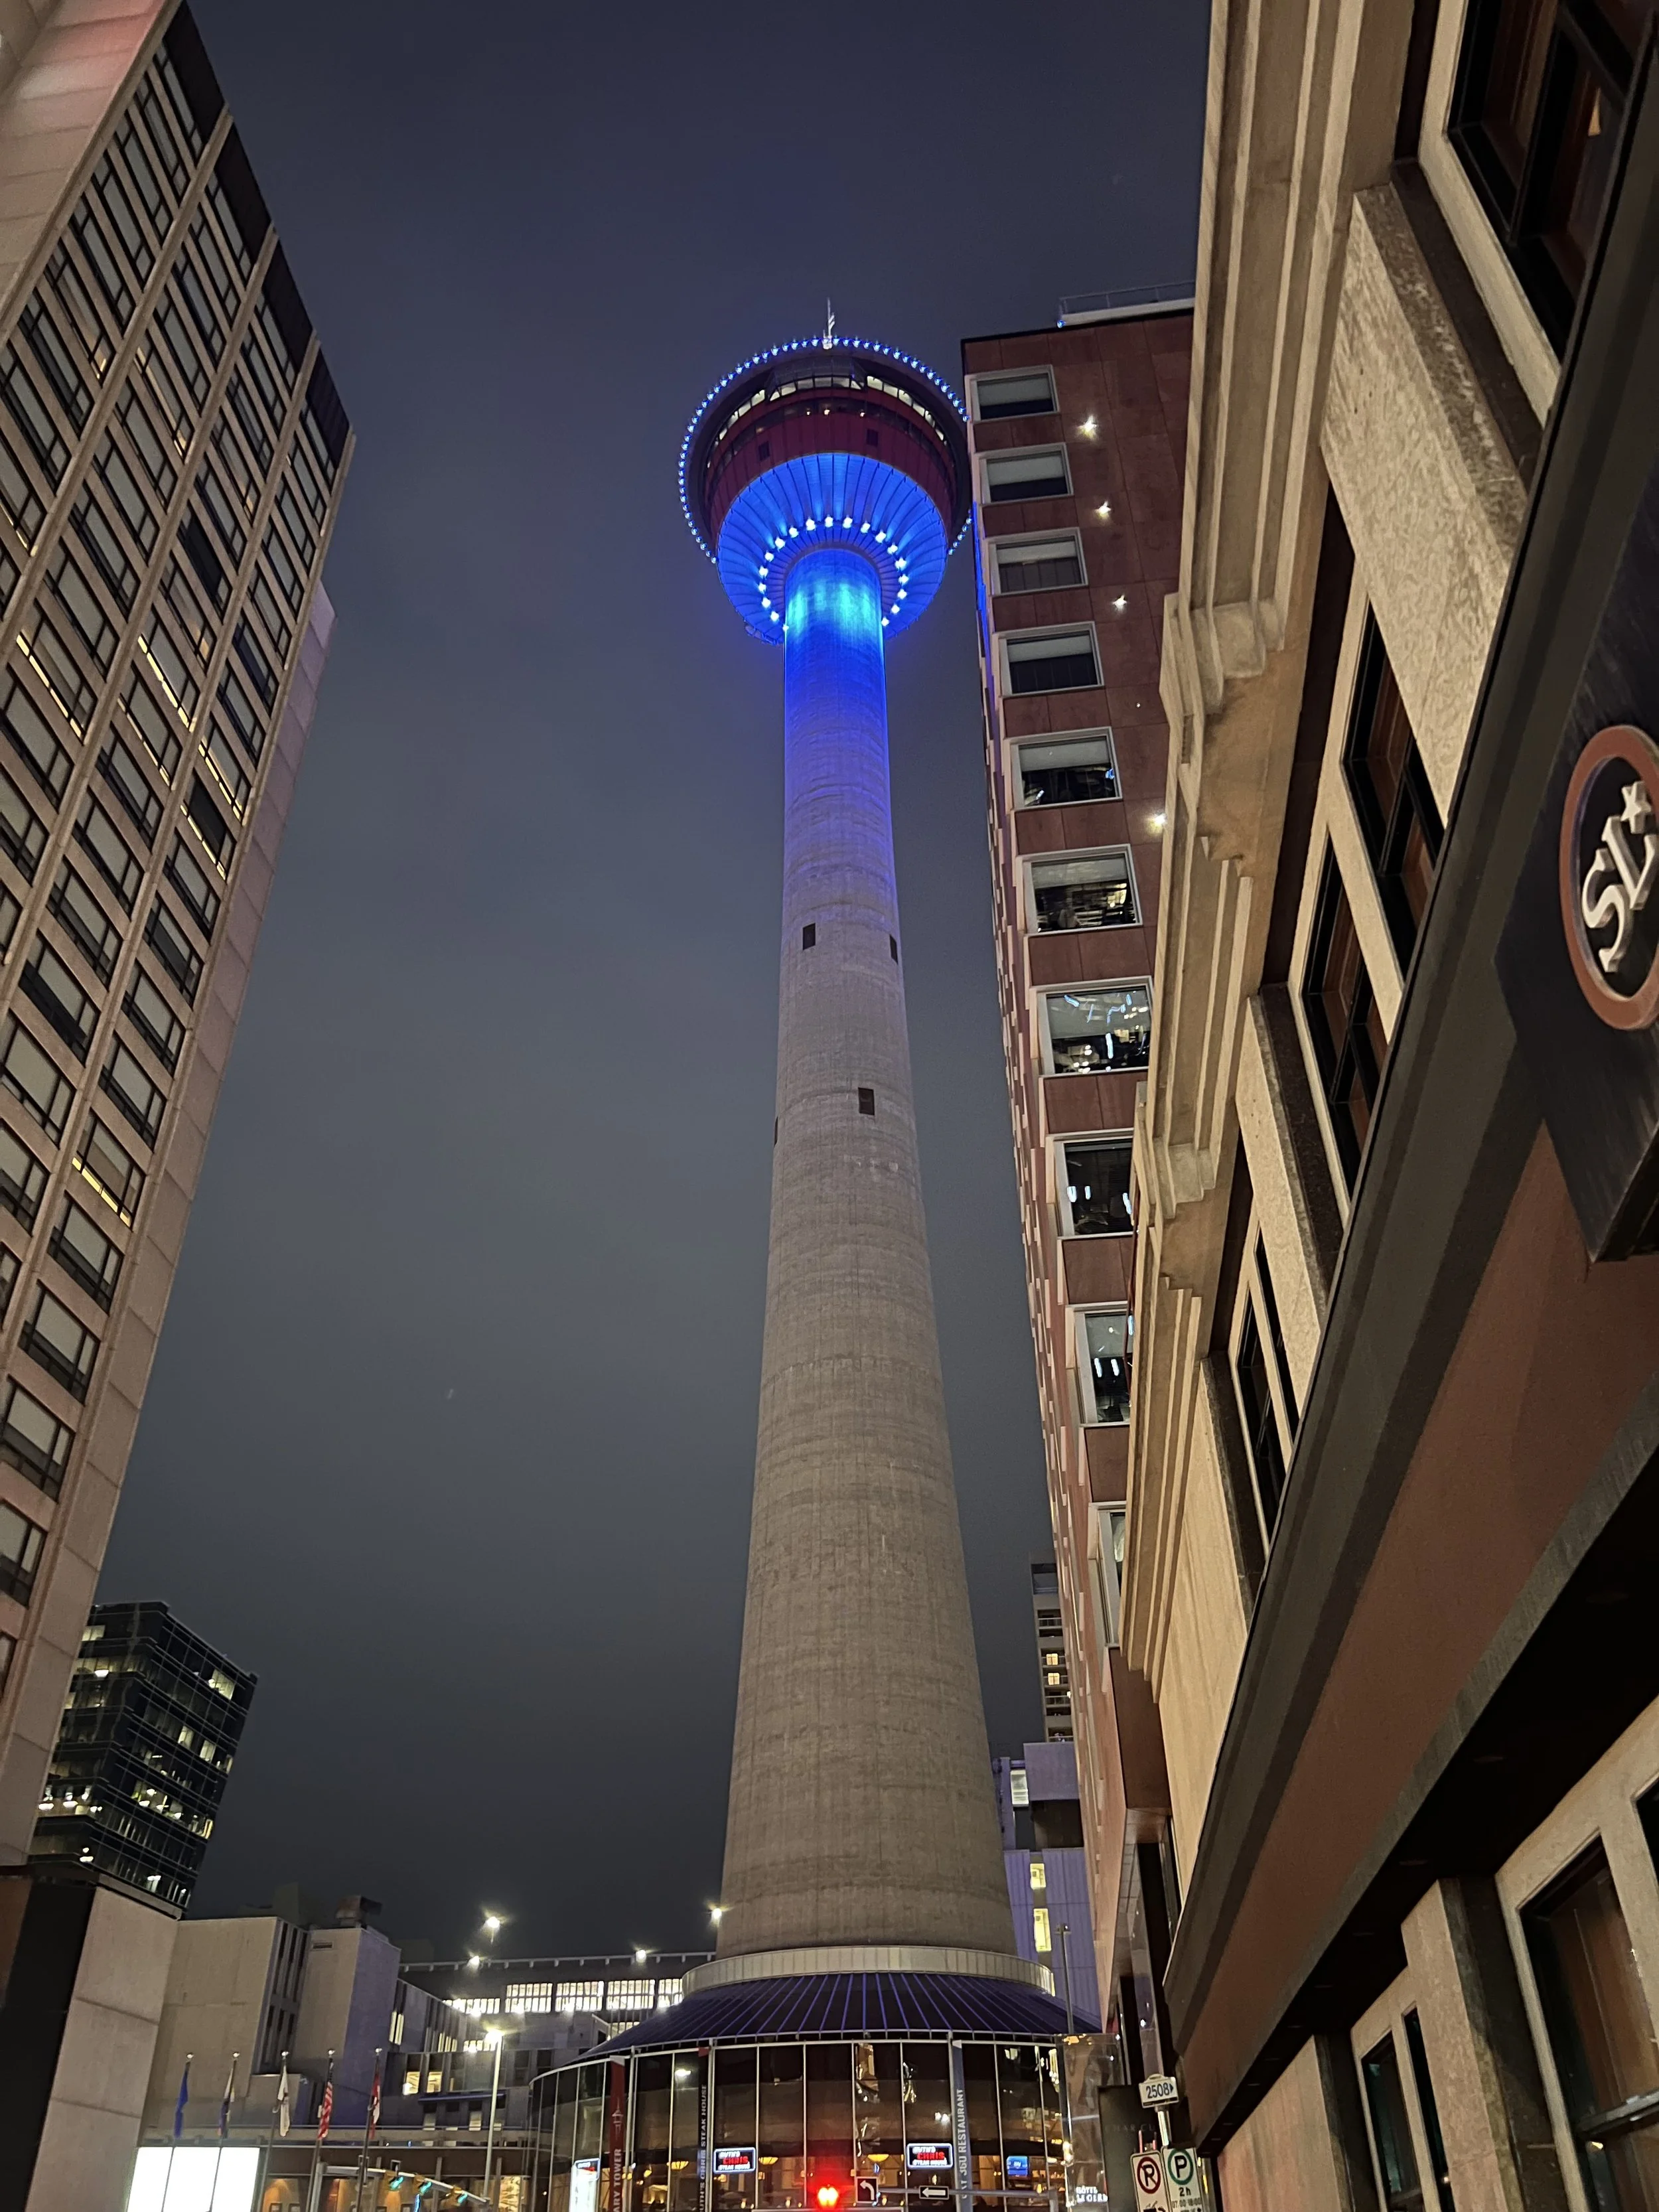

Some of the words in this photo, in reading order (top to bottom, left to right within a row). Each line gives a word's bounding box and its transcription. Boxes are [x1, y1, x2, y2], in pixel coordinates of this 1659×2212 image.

[1146, 2082, 1169, 2099] 2508
[957, 2089, 967, 2152] RESTAURANT
[613, 2148, 622, 2187] TOWER
[1174, 2155, 1187, 2177] P
